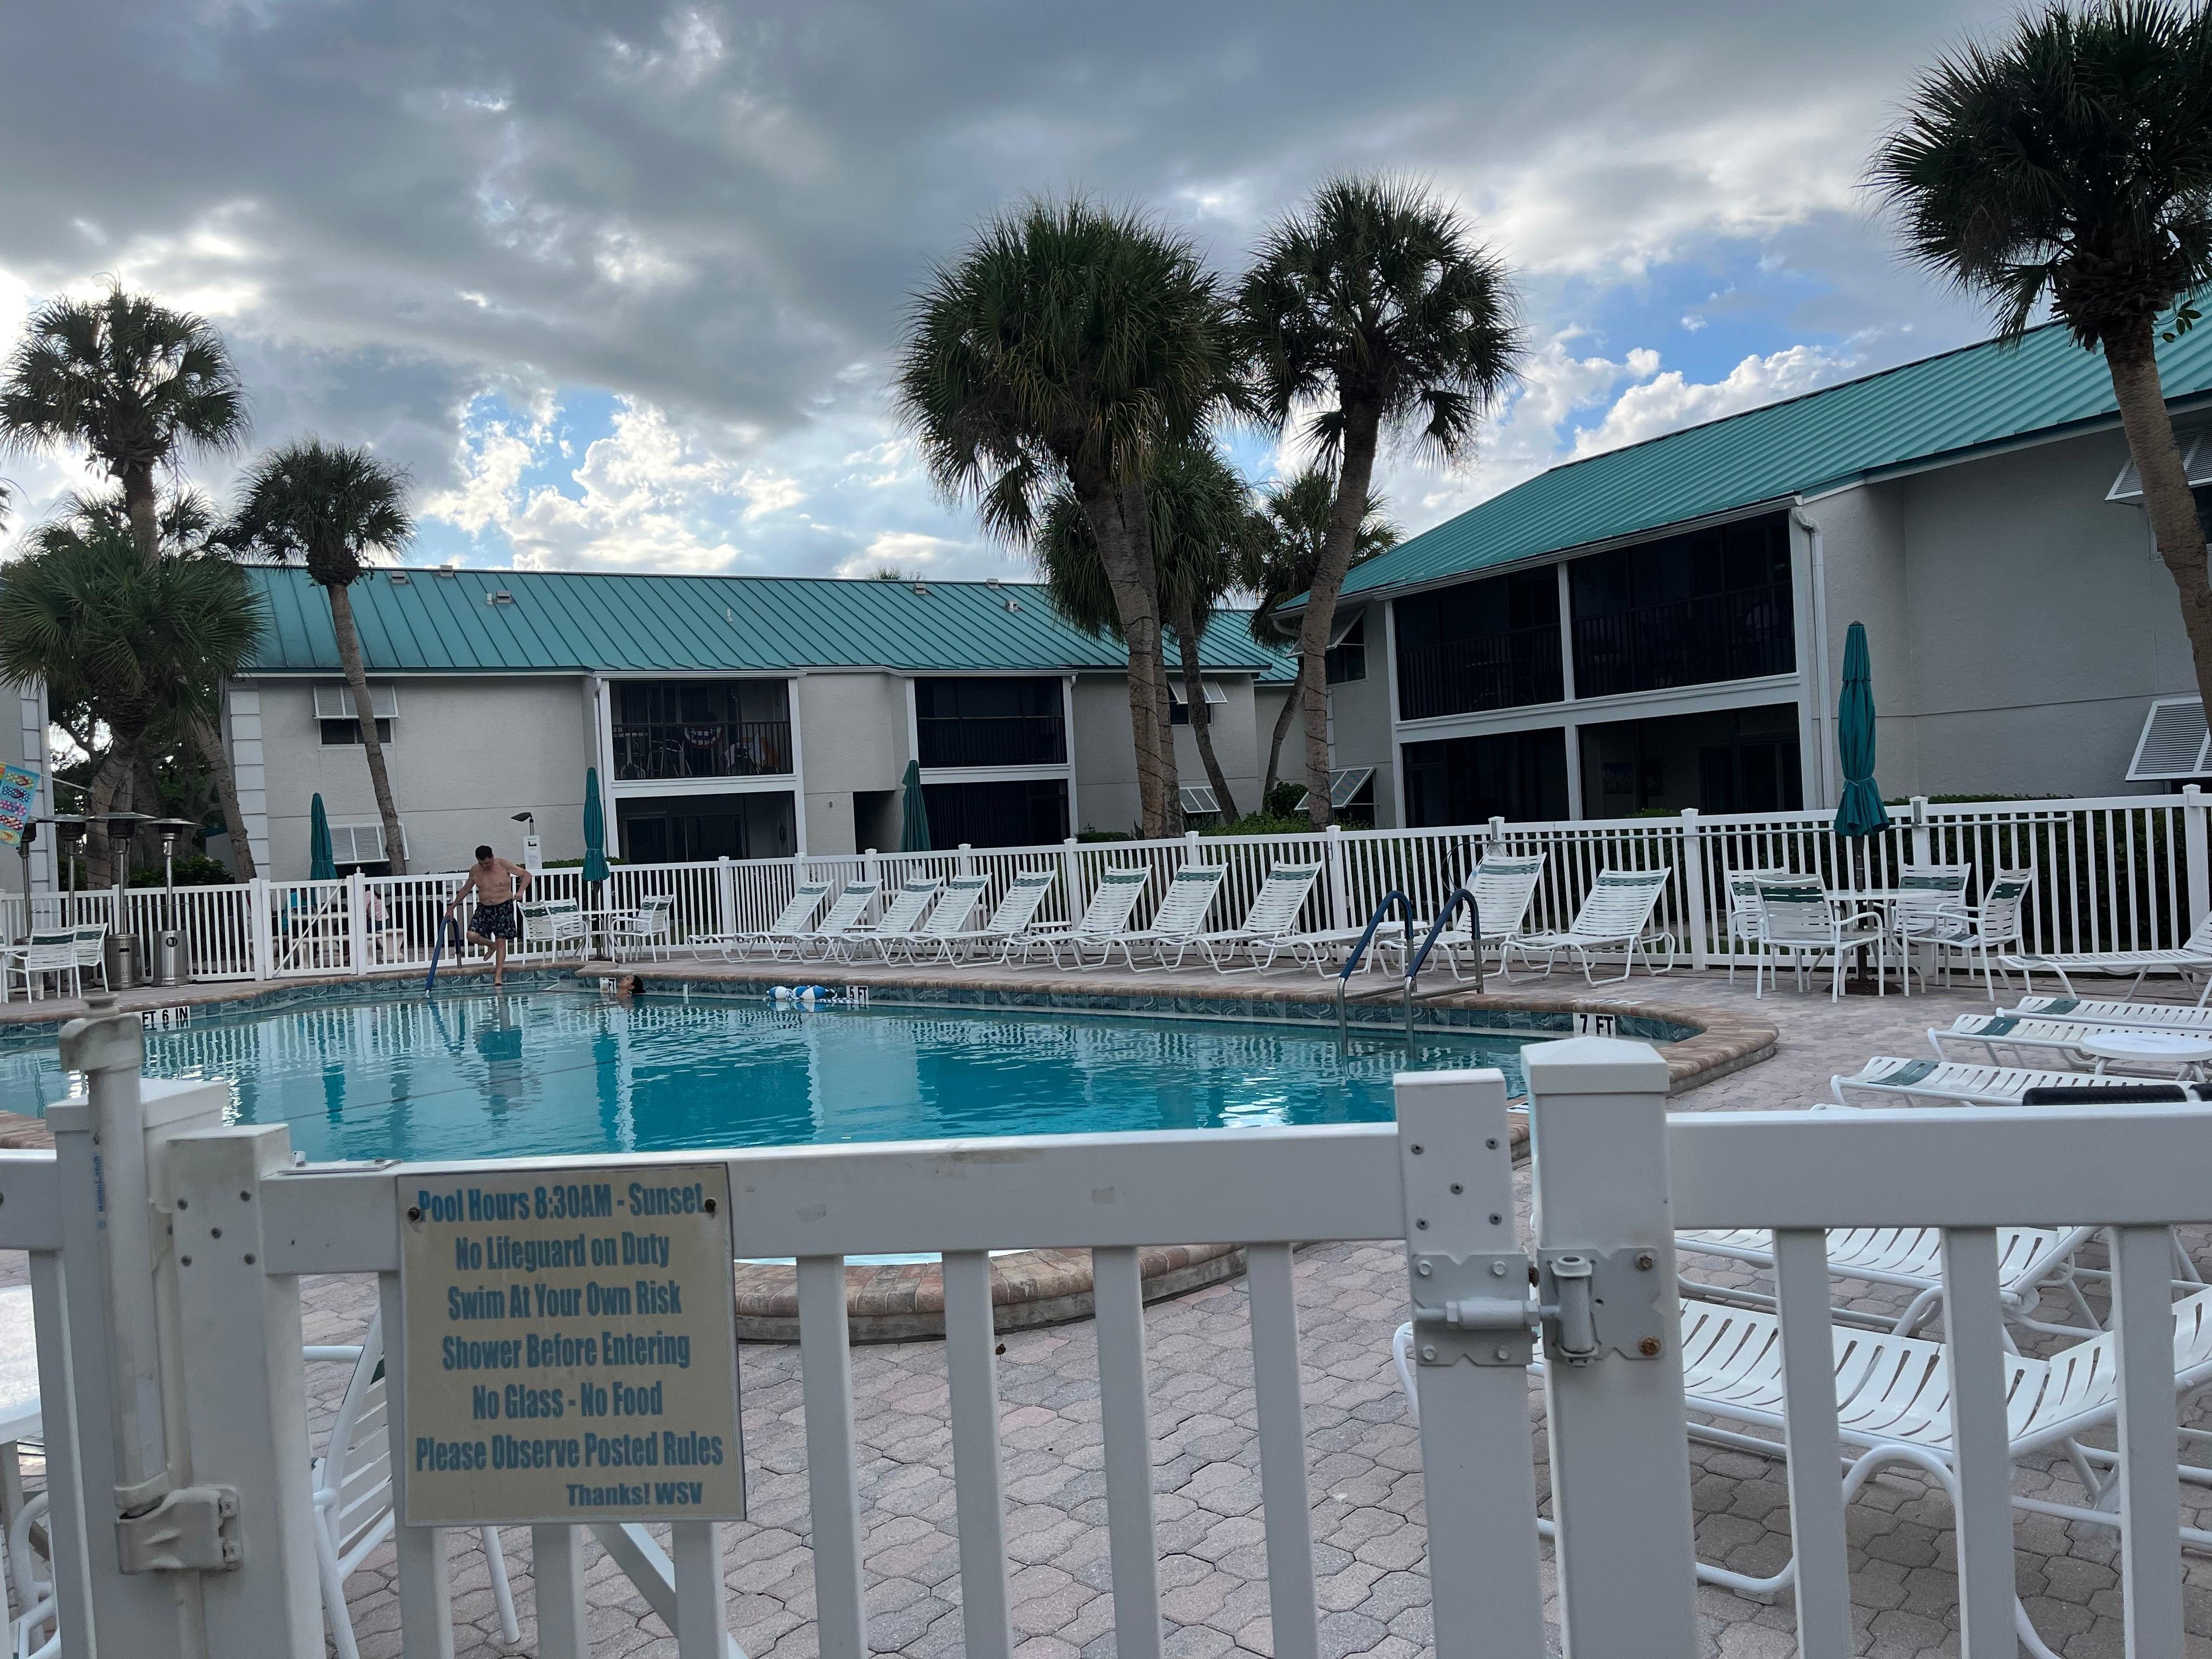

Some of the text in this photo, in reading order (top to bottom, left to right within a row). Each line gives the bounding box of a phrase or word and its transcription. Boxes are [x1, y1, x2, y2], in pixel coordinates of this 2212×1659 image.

[849, 986, 867, 1001] 5 FT
[142, 1007, 188, 1023] FT 6 IN
[1579, 1014, 1613, 1035] 7 FT
[418, 1189, 464, 1223] Pool
[466, 1187, 529, 1221] Hours
[533, 1183, 612, 1220] 8:30AM
[628, 1181, 704, 1216] Sunset
[455, 1232, 669, 1272] No Lifeguard on Duty
[448, 1280, 681, 1321] Swim At Your Own Risk
[441, 1330, 690, 1370] Shower Before Entering
[472, 1386, 499, 1420] No
[504, 1384, 564, 1419] Glass
[580, 1383, 607, 1417] No
[612, 1380, 663, 1416] Food
[415, 1431, 724, 1471] Please Observe Posted Rules
[566, 1481, 702, 1506] Thanks! WSV
